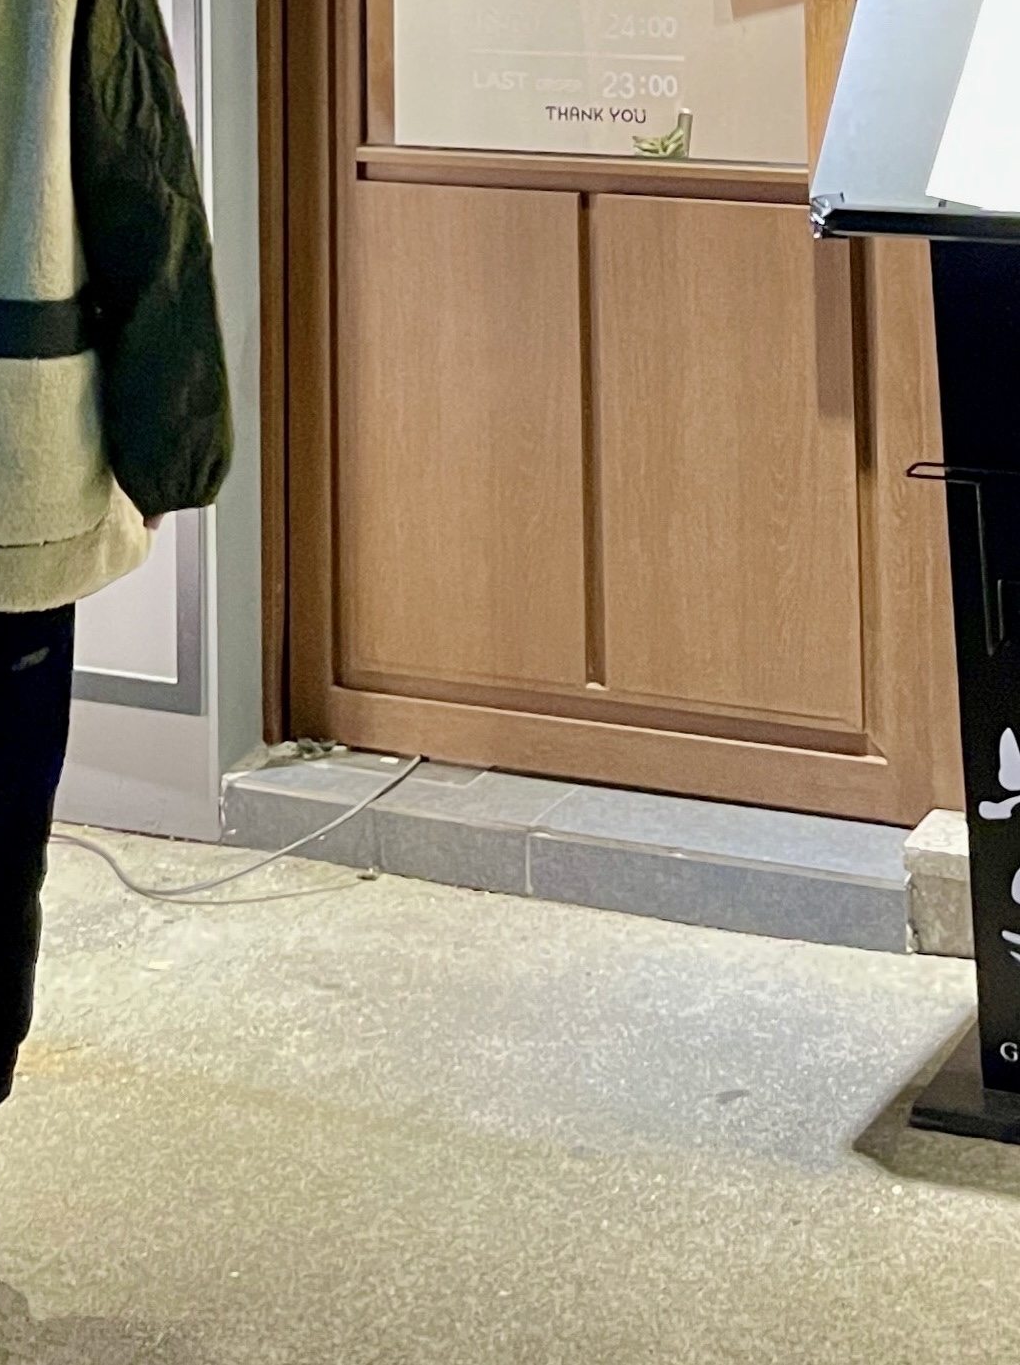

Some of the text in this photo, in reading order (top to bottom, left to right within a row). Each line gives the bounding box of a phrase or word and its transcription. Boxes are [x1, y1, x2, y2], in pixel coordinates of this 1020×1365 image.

[604, 14, 677, 40] 24:00
[472, 70, 528, 91] LAST
[602, 71, 678, 99] 23:00
[545, 105, 647, 124] THANK YOU
